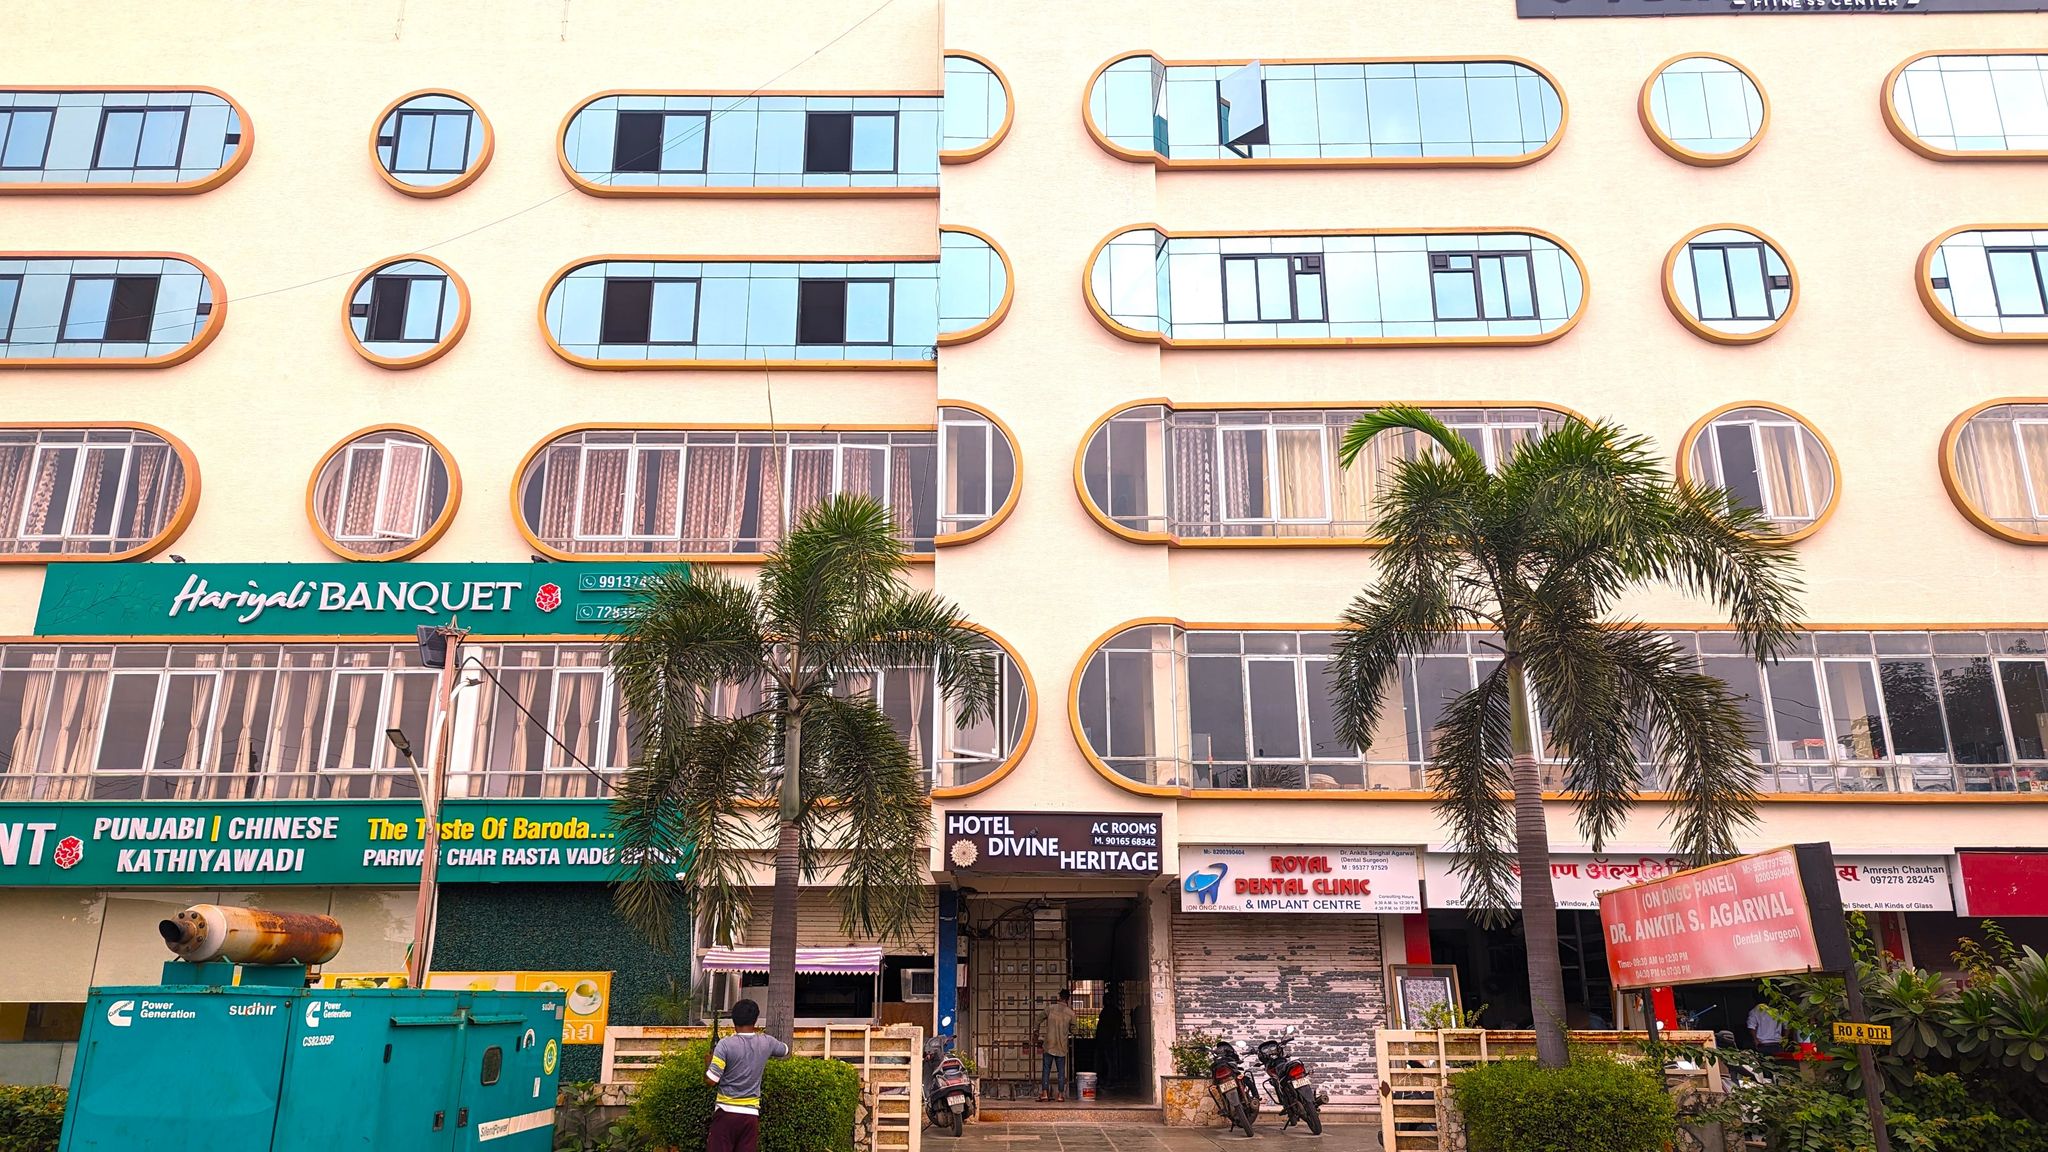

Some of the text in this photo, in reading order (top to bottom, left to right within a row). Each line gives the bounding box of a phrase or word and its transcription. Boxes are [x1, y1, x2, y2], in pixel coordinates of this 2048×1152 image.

[168, 573, 522, 623] Hariyali BANQUET
[92, 817, 205, 840] PUNJABI
[228, 816, 340, 840] CHINESE
[367, 817, 615, 840] The Tste Of Baroda...
[948, 815, 1014, 835] HOTEL
[1091, 822, 1157, 834] AC ROOMS
[988, 837, 1058, 856] DIVINE
[1094, 837, 1156, 846] M. 90165 68342
[116, 848, 305, 873] KATHIYAWADI
[362, 848, 442, 867] PARIVA
[446, 848, 497, 866] CHAR
[502, 847, 560, 866] RASTA
[1060, 851, 1159, 870] HERITAGE
[1270, 856, 1332, 873] ROYAL
[1862, 865, 1944, 874] Amresh Chauhan
[1235, 878, 1371, 896] DENTAL CLINIC
[1870, 875, 1935, 884] 097278 28245
[1642, 873, 1738, 913] (ON ONGC PANEL)
[1245, 899, 1362, 910] & IMPLANT CENTRE
[1609, 892, 1795, 944] DR. ANKITA S. AGARWAL
[1732, 926, 1801, 949] (Dental Surgeon)
[1648, 956, 1658, 965] AM
[1679, 951, 1689, 961] PM
[141, 1000, 174, 1010] Power
[228, 1002, 277, 1016] sudhir
[323, 1001, 342, 1010] Power
[140, 1009, 196, 1019] Generation
[323, 1010, 352, 1019] Generation
[1838, 1025, 1888, 1039] RO & DTH
